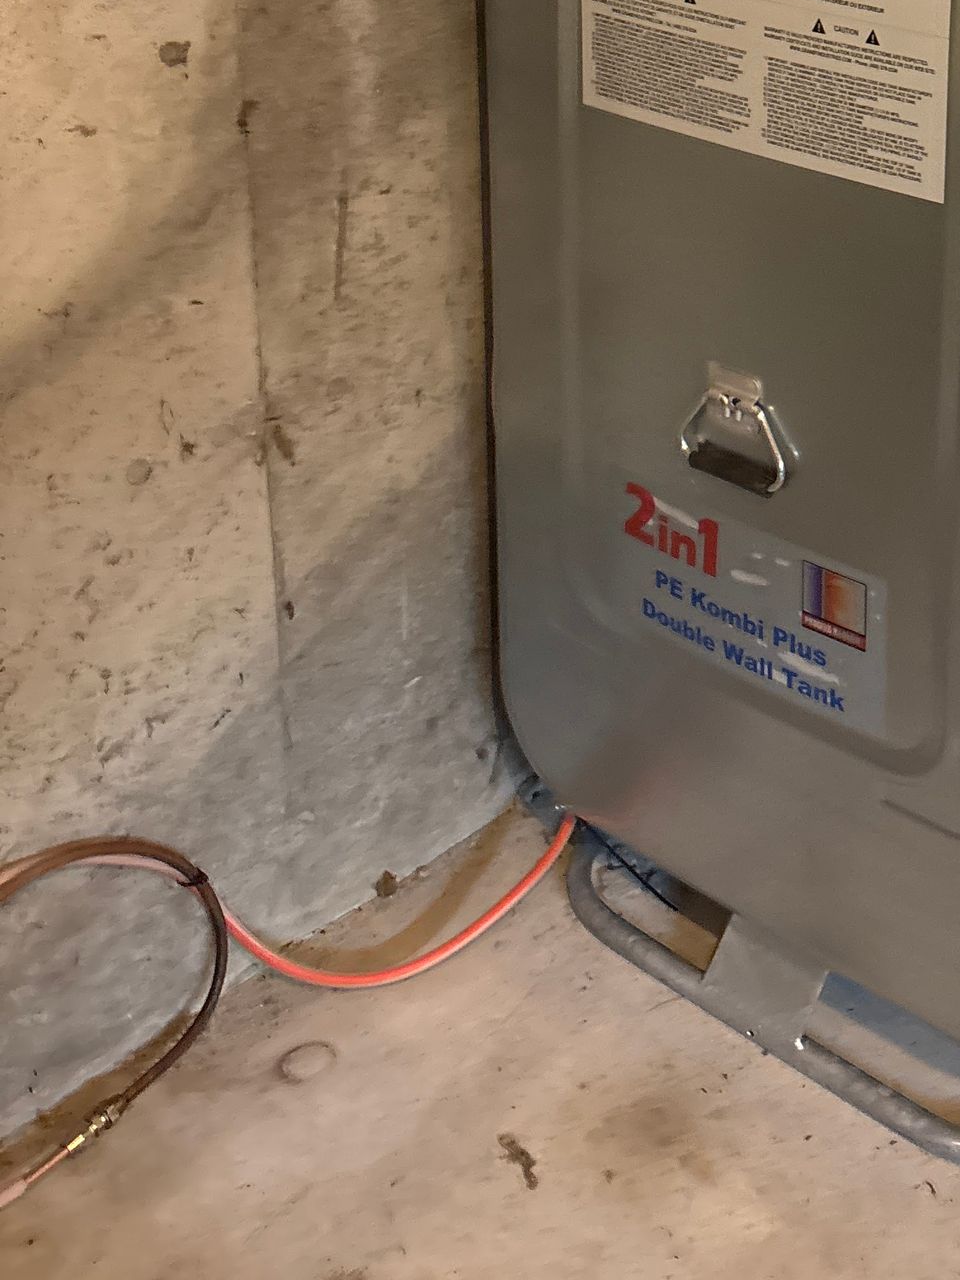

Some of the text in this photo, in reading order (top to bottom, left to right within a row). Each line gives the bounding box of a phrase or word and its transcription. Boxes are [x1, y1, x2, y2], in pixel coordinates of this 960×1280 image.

[834, 25, 859, 37] CAUTION
[624, 481, 719, 577] 2in1
[642, 598, 845, 712] Double Wall Tank
[655, 569, 683, 601] PE
[690, 587, 764, 640] Kombi
[773, 626, 827, 667] Plus
